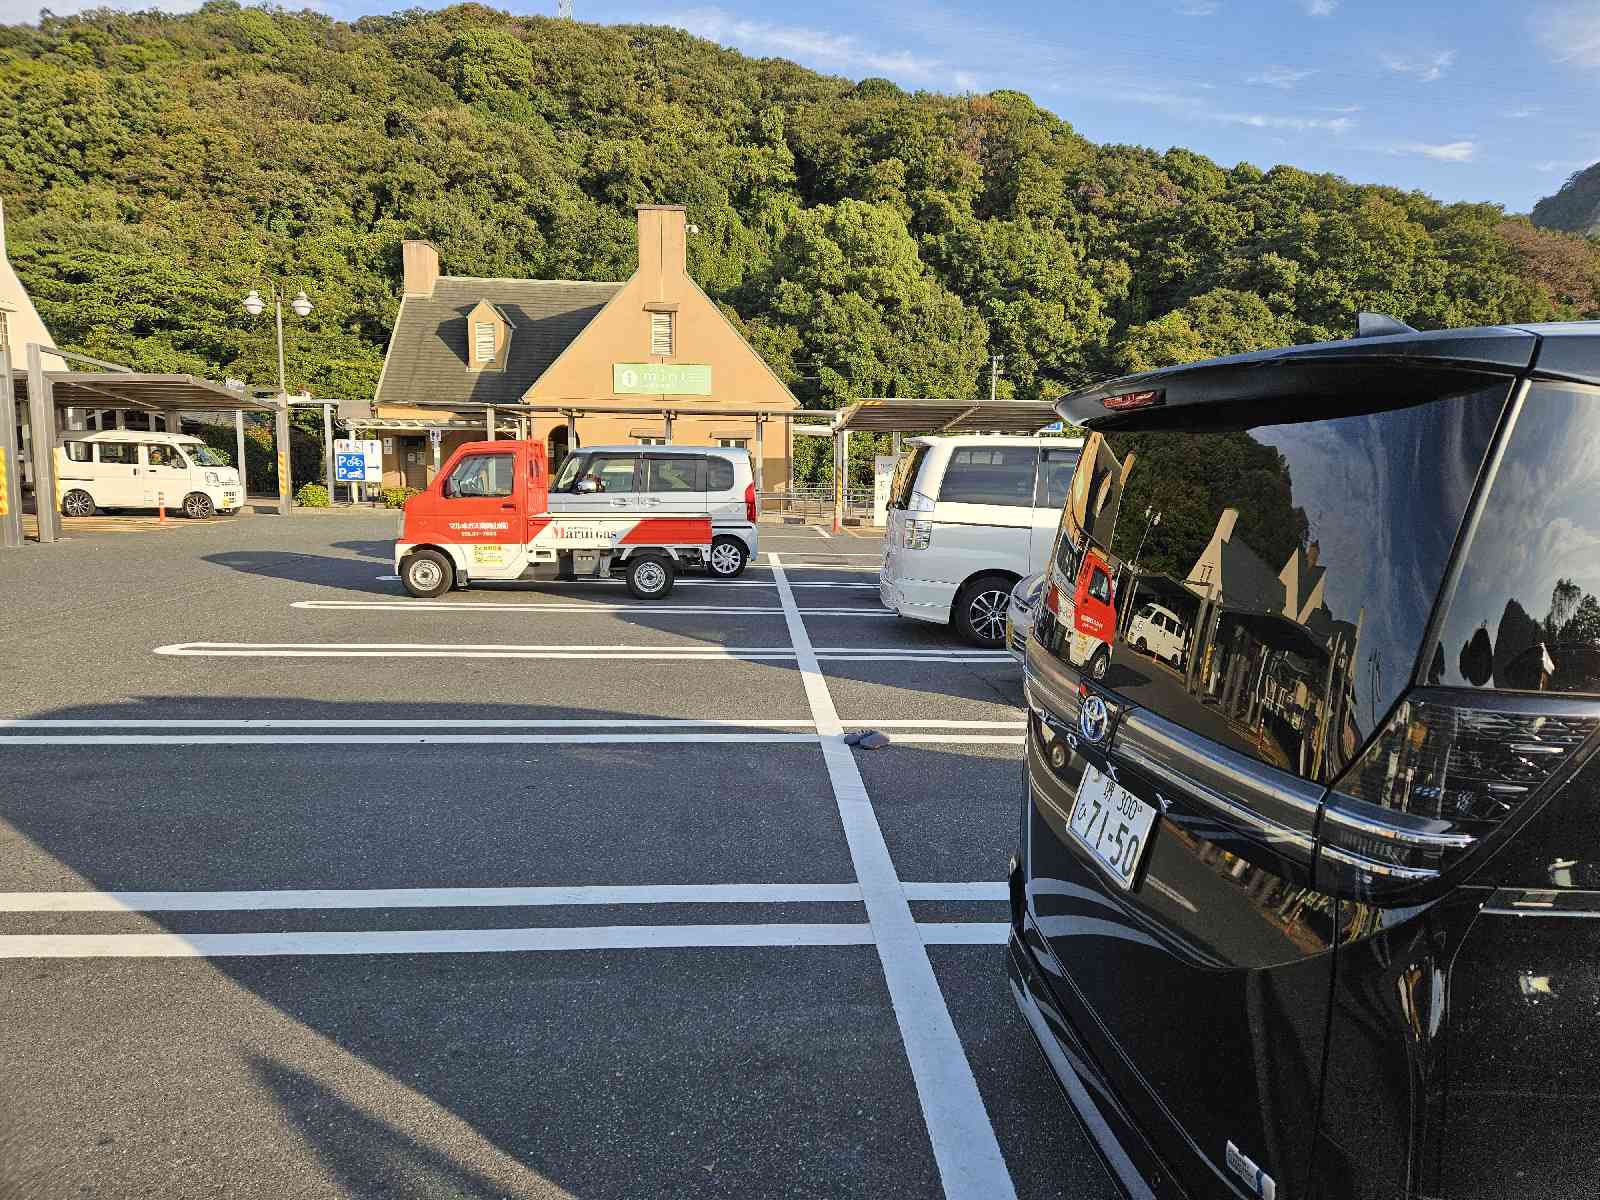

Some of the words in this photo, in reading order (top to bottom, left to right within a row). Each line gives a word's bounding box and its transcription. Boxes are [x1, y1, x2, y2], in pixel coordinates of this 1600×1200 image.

[338, 455, 347, 467] P
[339, 467, 347, 478] P
[1116, 791, 1139, 820] 300
[1082, 799, 1140, 877] 71-50
